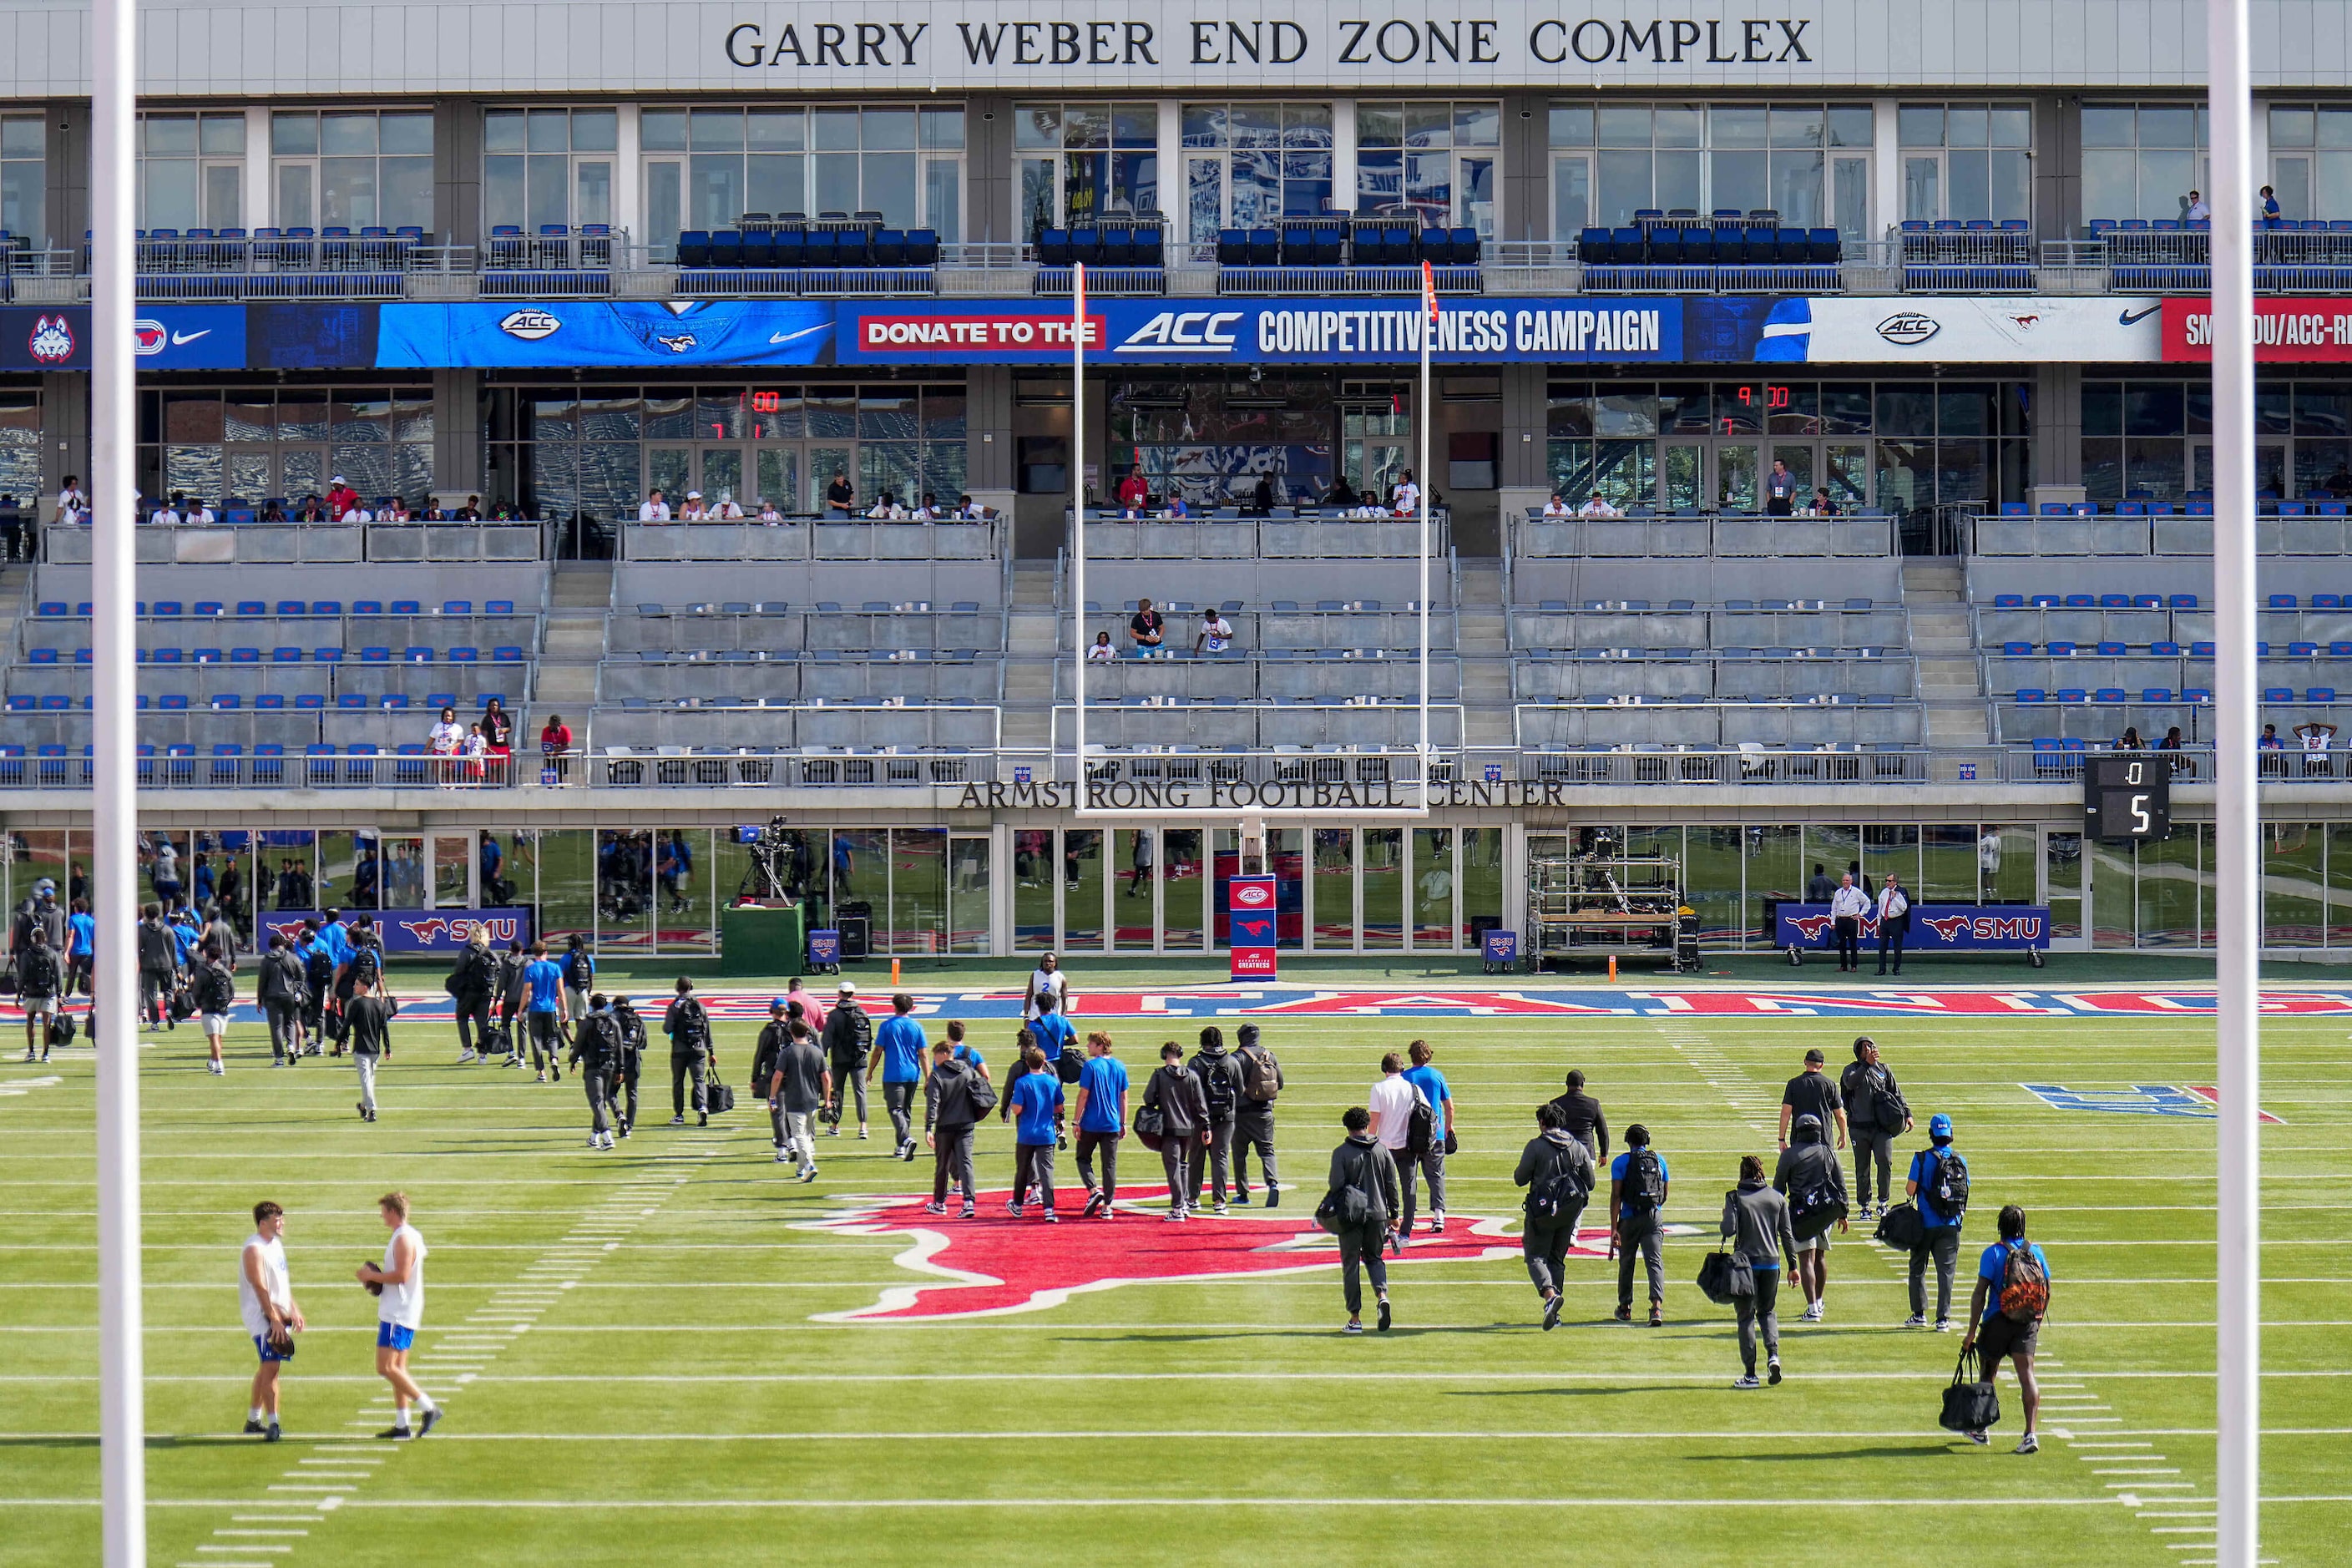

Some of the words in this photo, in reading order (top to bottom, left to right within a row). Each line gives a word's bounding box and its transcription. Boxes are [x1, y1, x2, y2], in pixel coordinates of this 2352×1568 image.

[726, 23, 928, 68] GARRY
[957, 22, 1159, 65] WEBER
[1190, 21, 1308, 64] END
[1338, 20, 1500, 63] ZONE
[1530, 19, 1812, 63] COMPLEX
[508, 316, 554, 327] ACC
[868, 322, 988, 343] DONATE
[992, 322, 1033, 343] TO
[1039, 322, 1095, 343] THE
[1122, 311, 1244, 344] ACC
[1259, 311, 1507, 352] COMPETITIVENESS
[1515, 310, 1659, 351] CAMPAIGN
[1884, 319, 1931, 331] ACC
[2186, 313, 2352, 345] SMDU/ACC-R
[958, 781, 1190, 808] ARMSTRONG
[1210, 780, 1404, 807] FOOTBALL
[1426, 780, 1565, 807] CENTER
[2131, 795, 2149, 832] 5
[1972, 917, 2042, 940] SMU
[812, 938, 836, 948] SMU
[1490, 937, 1513, 947] SMU
[1041, 982, 1050, 992] 2
